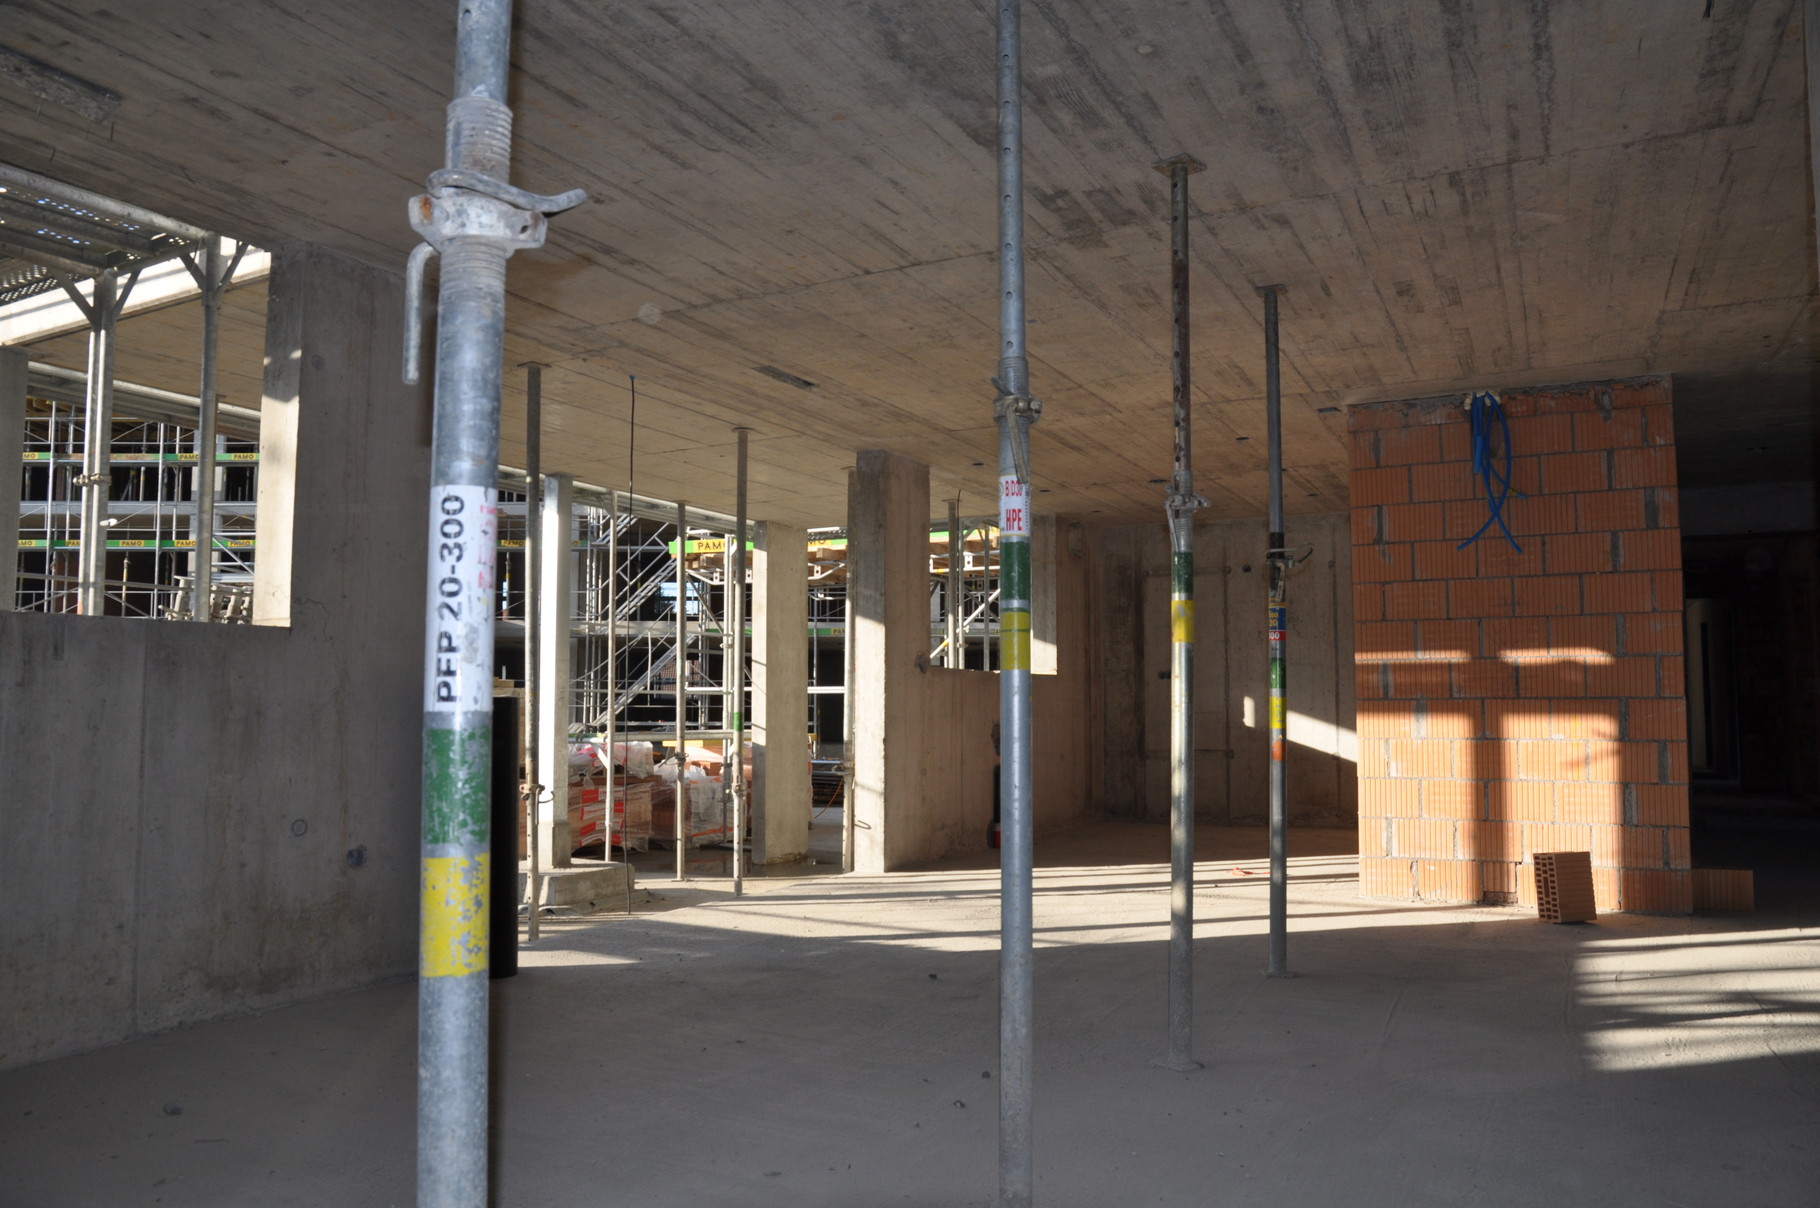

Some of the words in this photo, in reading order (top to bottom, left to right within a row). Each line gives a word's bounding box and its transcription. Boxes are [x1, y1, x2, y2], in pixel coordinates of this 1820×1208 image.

[1005, 508, 1022, 531] HPE
[697, 541, 725, 550] PAM
[436, 494, 465, 622] 20-300
